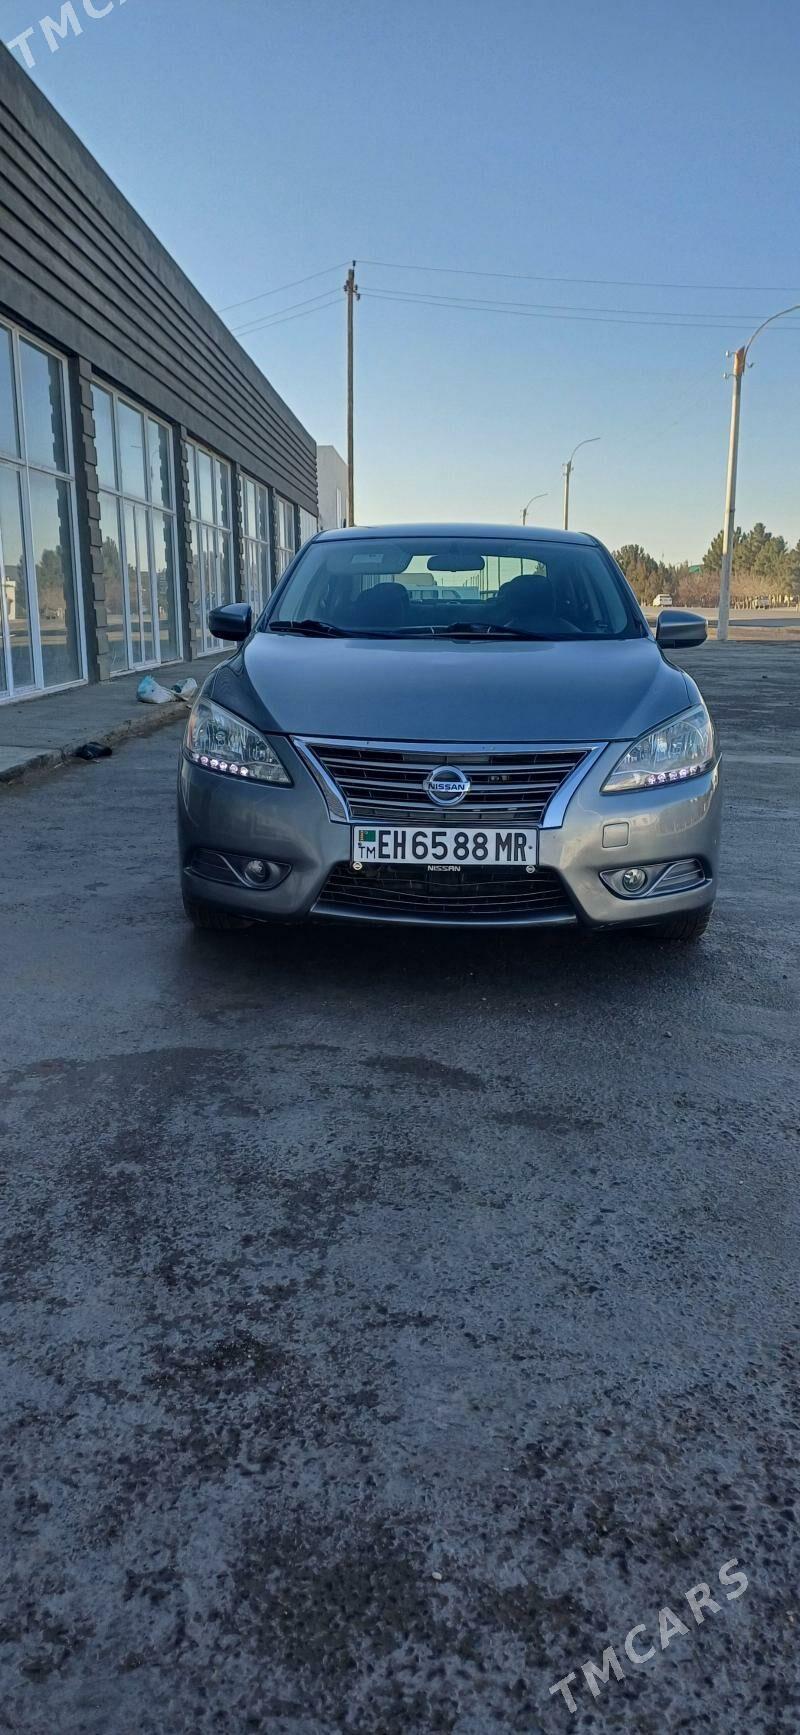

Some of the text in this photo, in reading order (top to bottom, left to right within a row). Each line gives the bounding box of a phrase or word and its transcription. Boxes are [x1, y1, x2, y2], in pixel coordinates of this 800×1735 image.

[428, 783, 465, 791] NISSAN
[358, 845, 376, 860] TM
[427, 864, 461, 872] NISSAN
